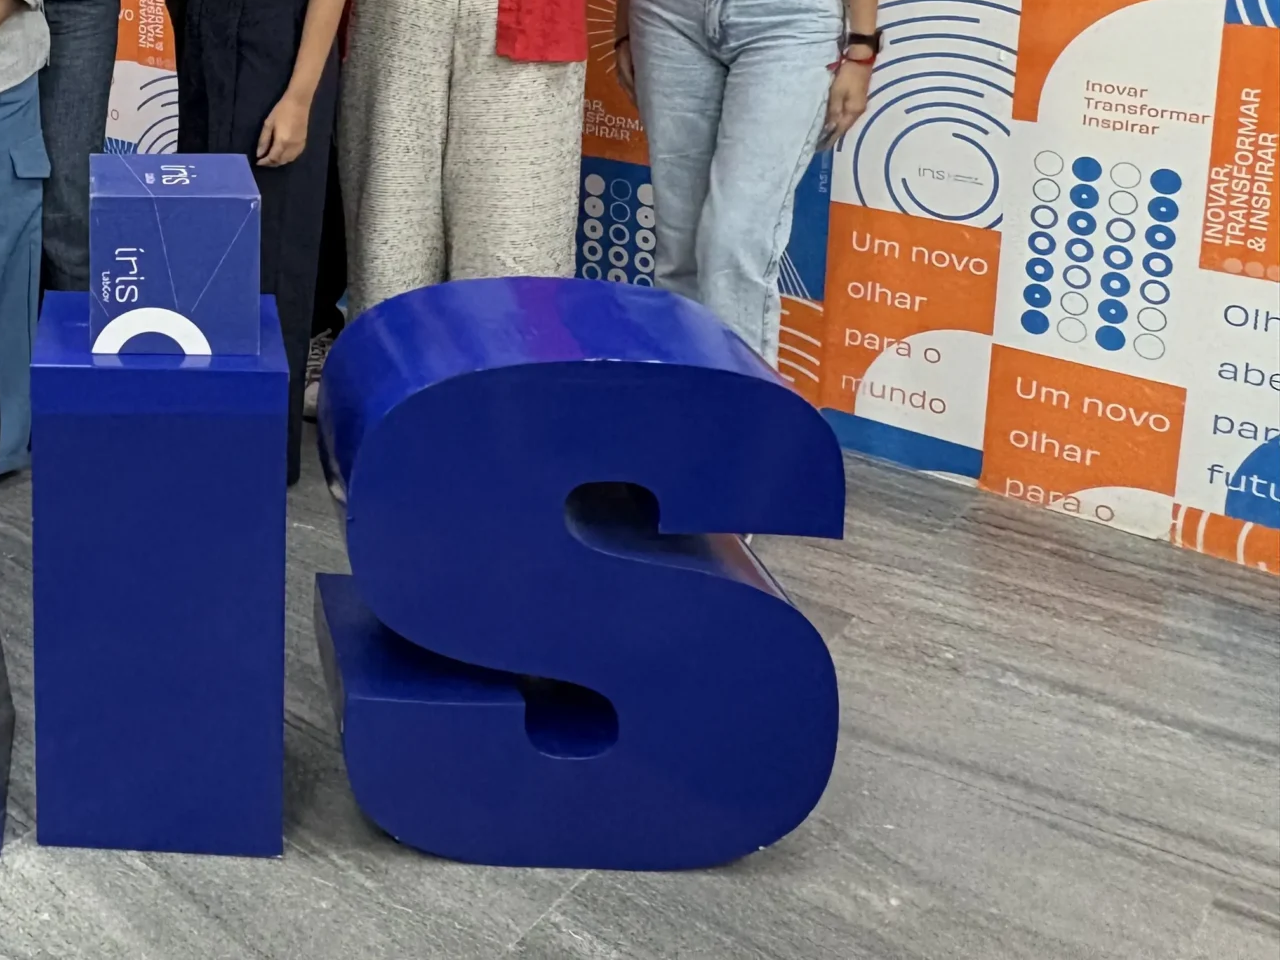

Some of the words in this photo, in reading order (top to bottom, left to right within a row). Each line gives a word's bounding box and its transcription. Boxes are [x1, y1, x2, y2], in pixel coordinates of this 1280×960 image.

[1084, 97, 1212, 124] Transformar
[1086, 80, 1148, 99] Inovar
[1082, 114, 1160, 136] Inspirar
[1225, 88, 1262, 246] TRANSFORMAR
[1249, 132, 1279, 231] INSPIRAR
[1203, 165, 1233, 245] INOVAR,
[852, 230, 901, 259] Um
[911, 243, 989, 276] novo
[1247, 236, 1266, 252] &
[115, 248, 145, 302] iris
[847, 280, 928, 313] olhar
[845, 327, 912, 359] para
[923, 346, 941, 364] o
[841, 373, 947, 415] mundo
[1016, 376, 1070, 410] Um
[1083, 391, 1171, 434] novo
[1009, 428, 1101, 467] olhar
[1005, 476, 1081, 515] para
[1095, 503, 1115, 523] o
